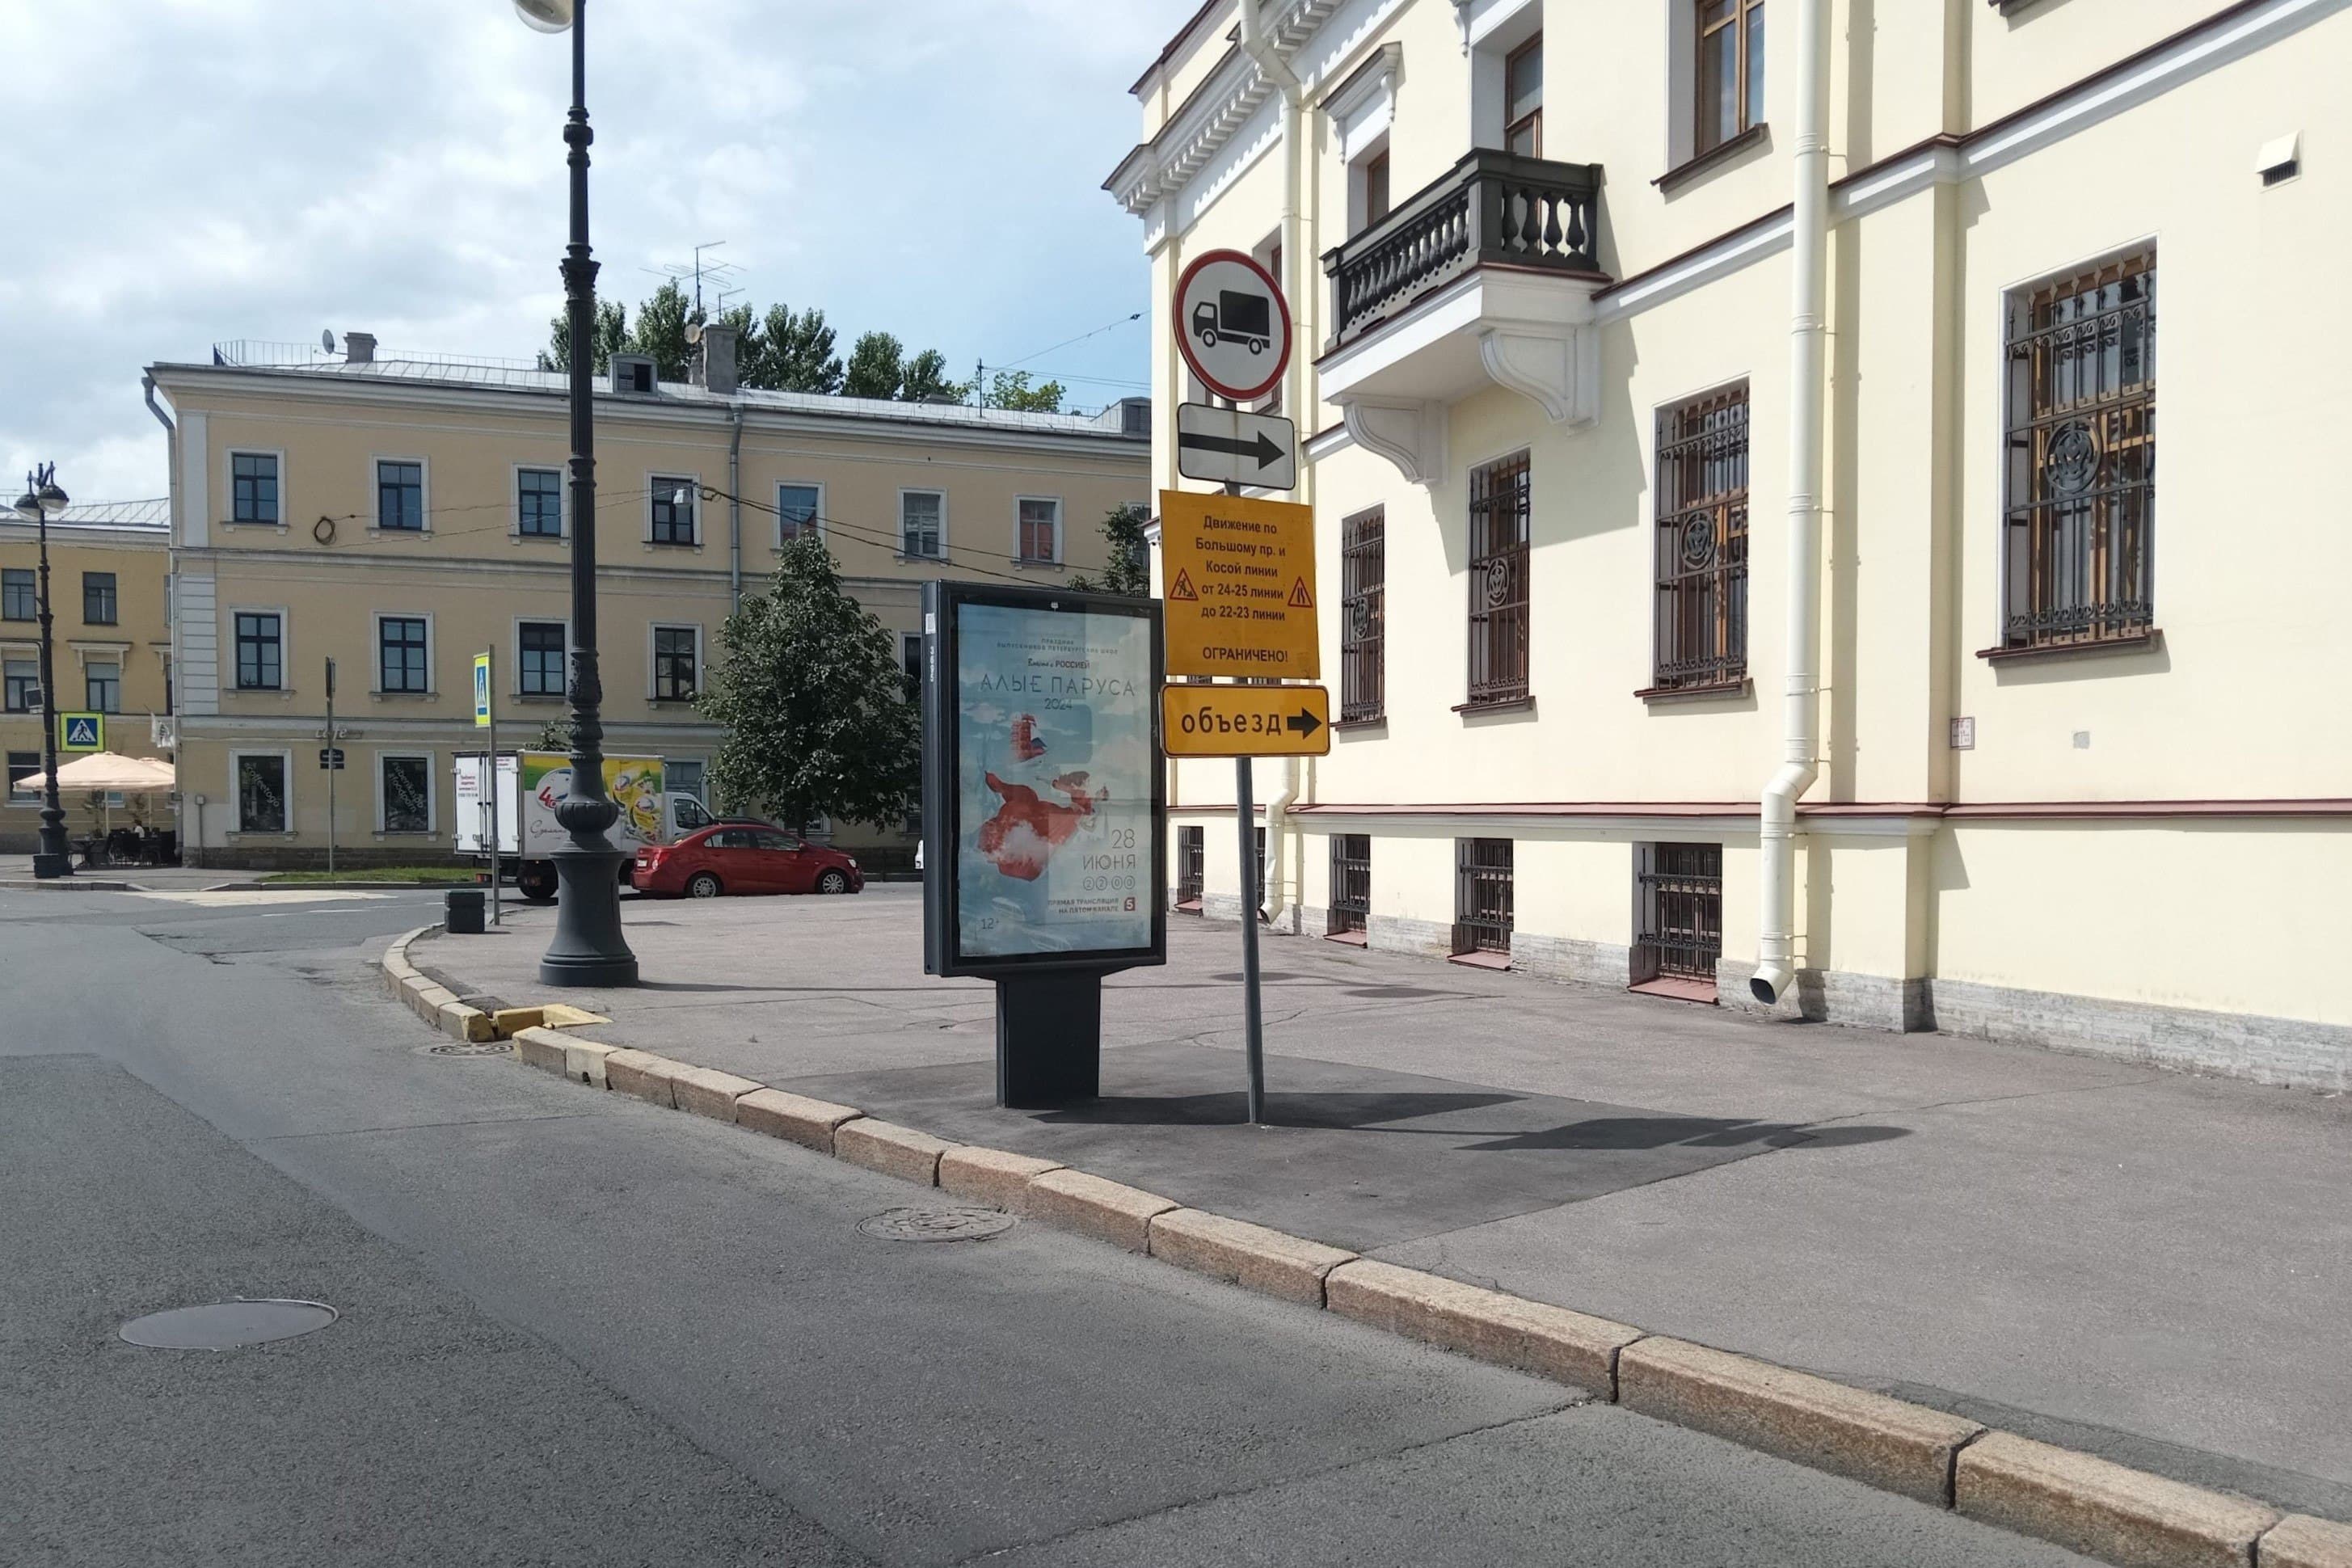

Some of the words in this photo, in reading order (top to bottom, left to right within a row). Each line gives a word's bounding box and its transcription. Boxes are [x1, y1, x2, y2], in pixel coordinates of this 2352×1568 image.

[1203, 516, 1261, 533] Движение
[1264, 524, 1278, 534] по
[1195, 537, 1257, 557] Большому
[1260, 545, 1275, 558] пр.
[1279, 547, 1286, 557] и
[1206, 560, 1241, 575] Косой
[1245, 566, 1279, 578] линии
[1202, 584, 1214, 595] от
[1217, 583, 1248, 597] 24-25
[1250, 588, 1284, 600] линии
[1201, 607, 1216, 618] до
[1219, 605, 1250, 619] 22-23
[1252, 609, 1286, 622] линии
[1203, 646, 1288, 664] ОГРАНИЧЕНО!
[980, 673, 1043, 693] АЛЫЕ
[1051, 677, 1136, 698] ПАРУСА
[1044, 698, 1073, 710] 2024
[1181, 706, 1282, 736] объезд
[1111, 828, 1136, 849] 28
[1082, 854, 1136, 870] ИЮНЯ
